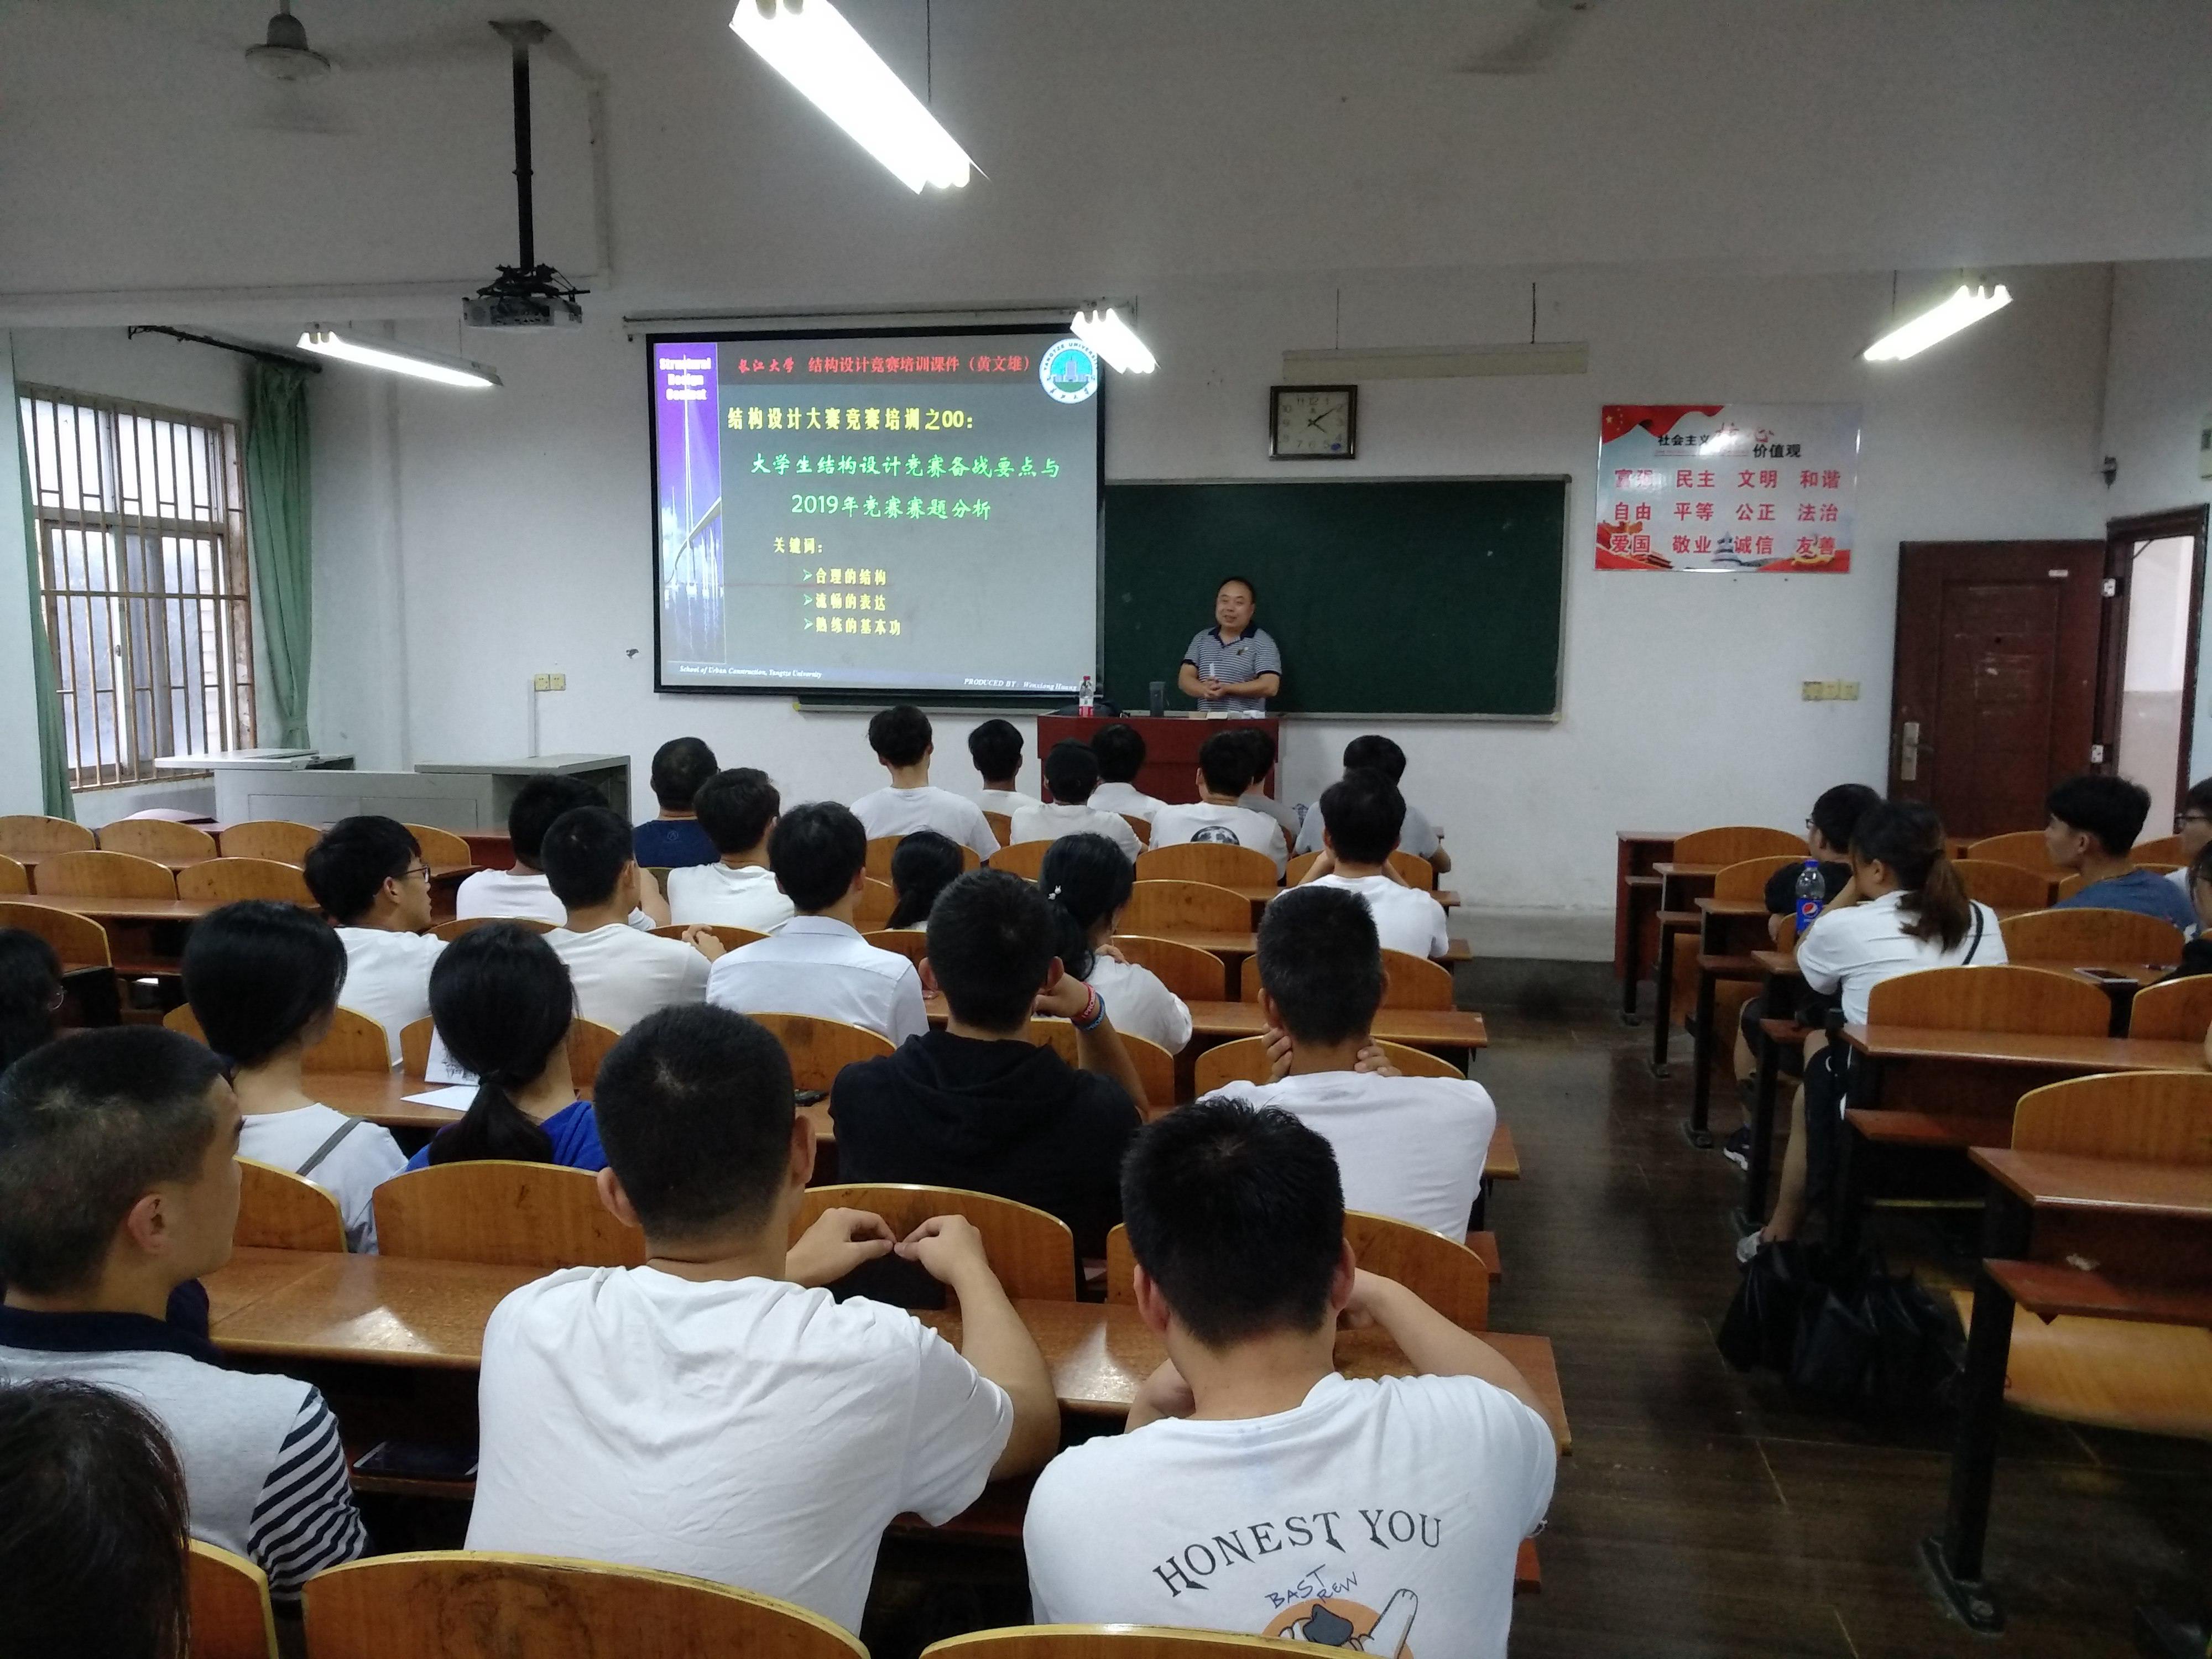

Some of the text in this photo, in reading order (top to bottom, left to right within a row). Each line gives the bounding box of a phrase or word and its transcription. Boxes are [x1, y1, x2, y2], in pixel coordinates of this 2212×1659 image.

[1752, 443, 1801, 458] 价值观
[750, 452, 1060, 478] 大学生结构设计竞赛备战要点与
[1676, 469, 1715, 489] 民主
[1737, 469, 1778, 489] 文明
[1799, 469, 1841, 489] 和谐
[791, 494, 991, 521] 2019年竞赛赛题分析
[1614, 502, 1839, 522] 自由 平等 公正 法治
[1611, 534, 1836, 555] 爱国 敬业 诚信 友善
[816, 567, 886, 586] 合理的结构
[816, 592, 886, 612] 流畅的表达
[964, 678, 1004, 687] PRODUCED
[1152, 1509, 1442, 1598] HONEST YOU
